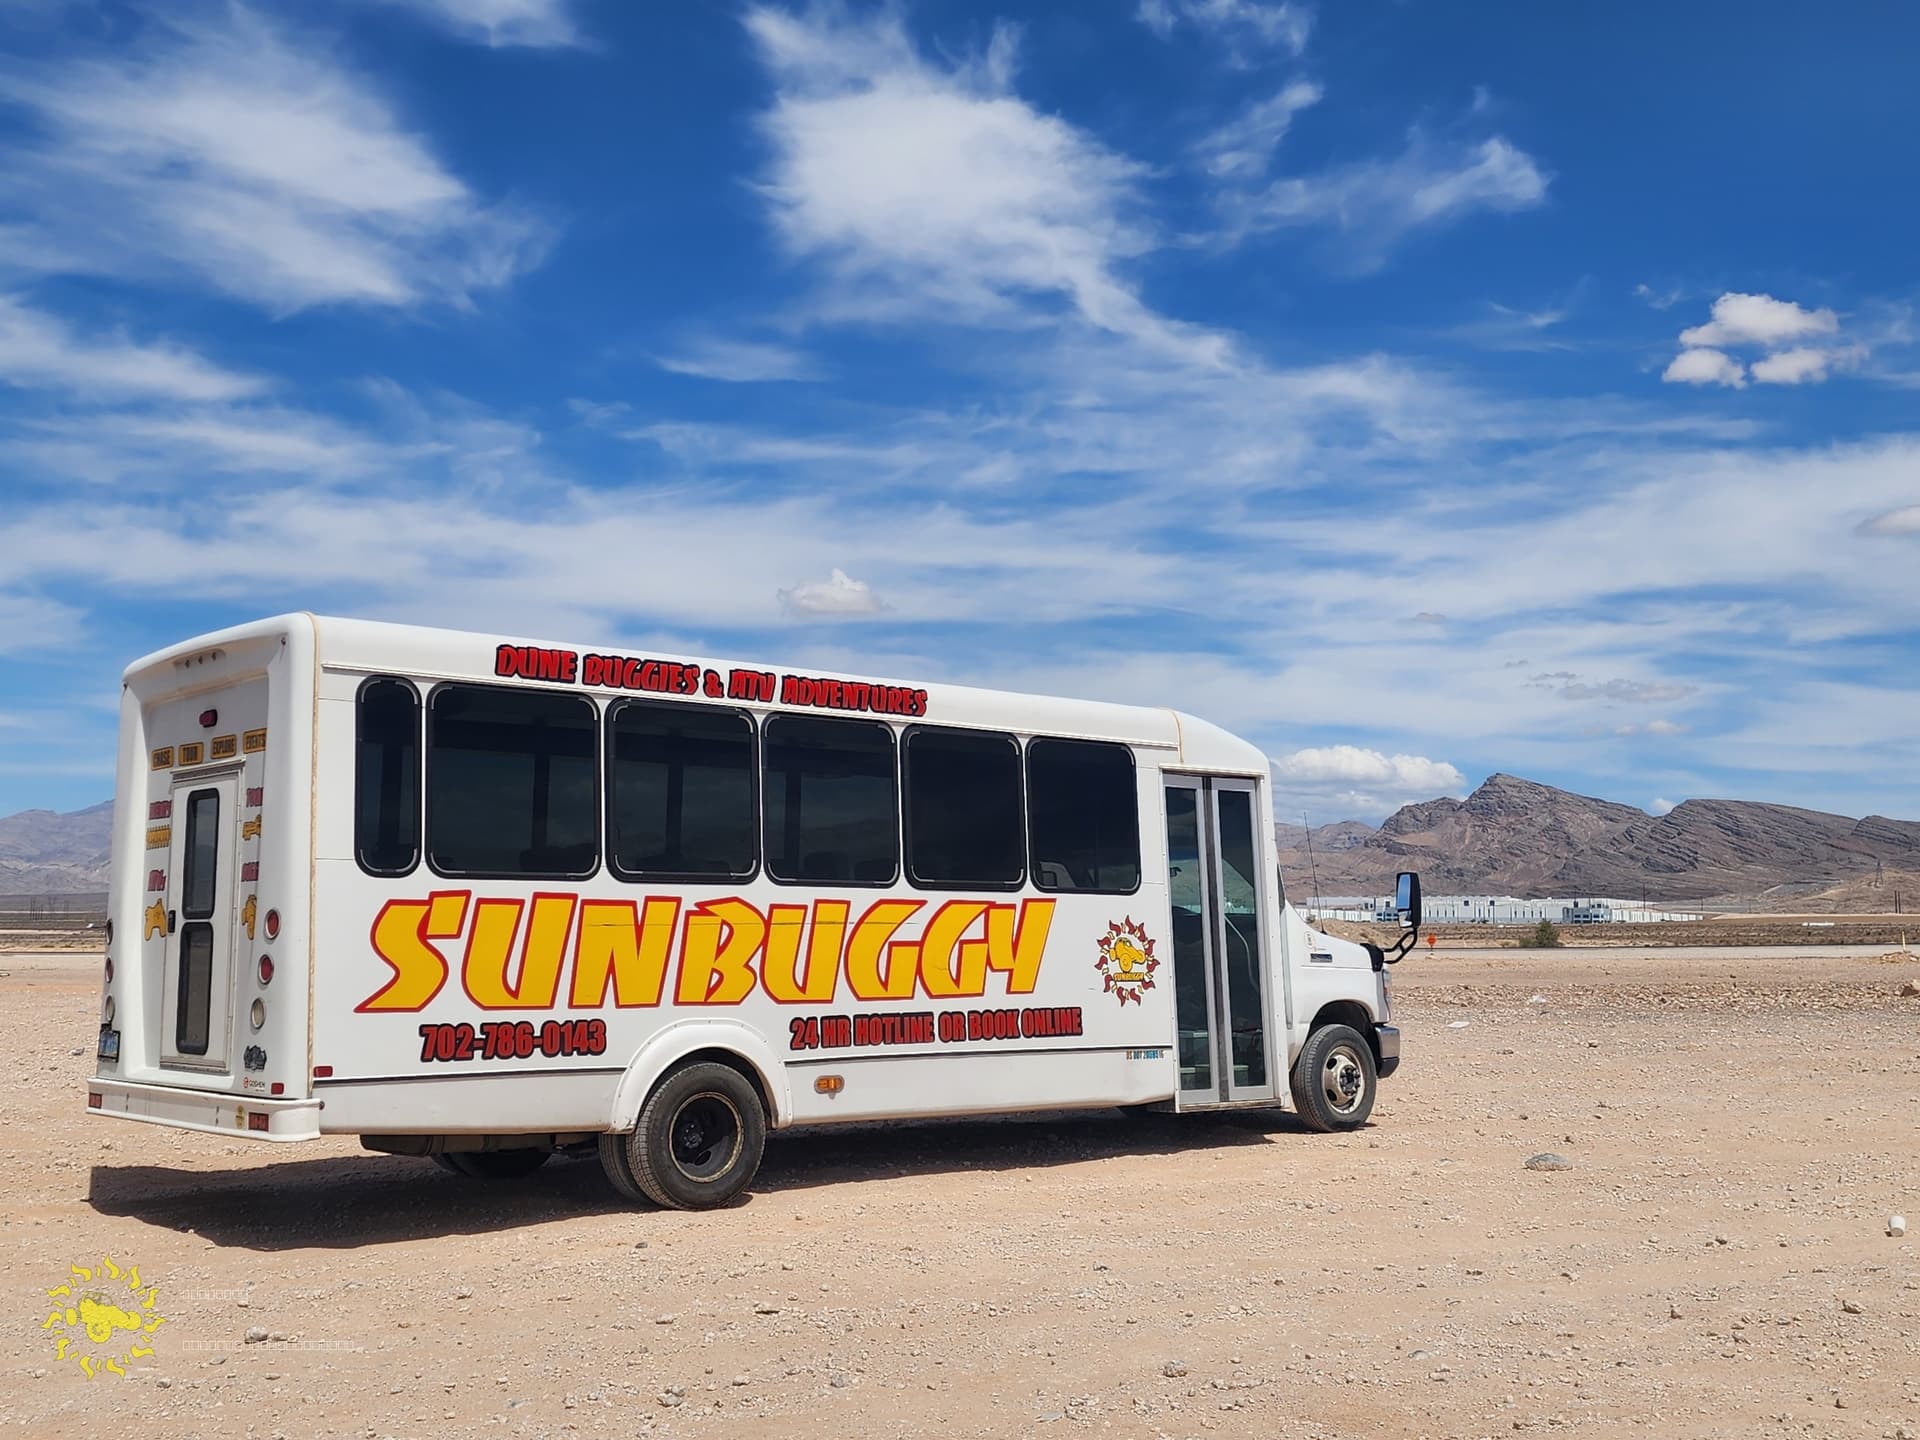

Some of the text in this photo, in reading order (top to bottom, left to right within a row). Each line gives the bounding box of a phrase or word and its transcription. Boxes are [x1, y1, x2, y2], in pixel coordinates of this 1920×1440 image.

[495, 644, 928, 717] DUNE BUGGIES & ATV ADVENTURES
[354, 890, 1056, 1013] SUNBUGGY
[419, 1018, 607, 1063] 702-786-0143
[789, 1007, 1084, 1050] 24 HR HOTLINE OR BOOK ONLINE
